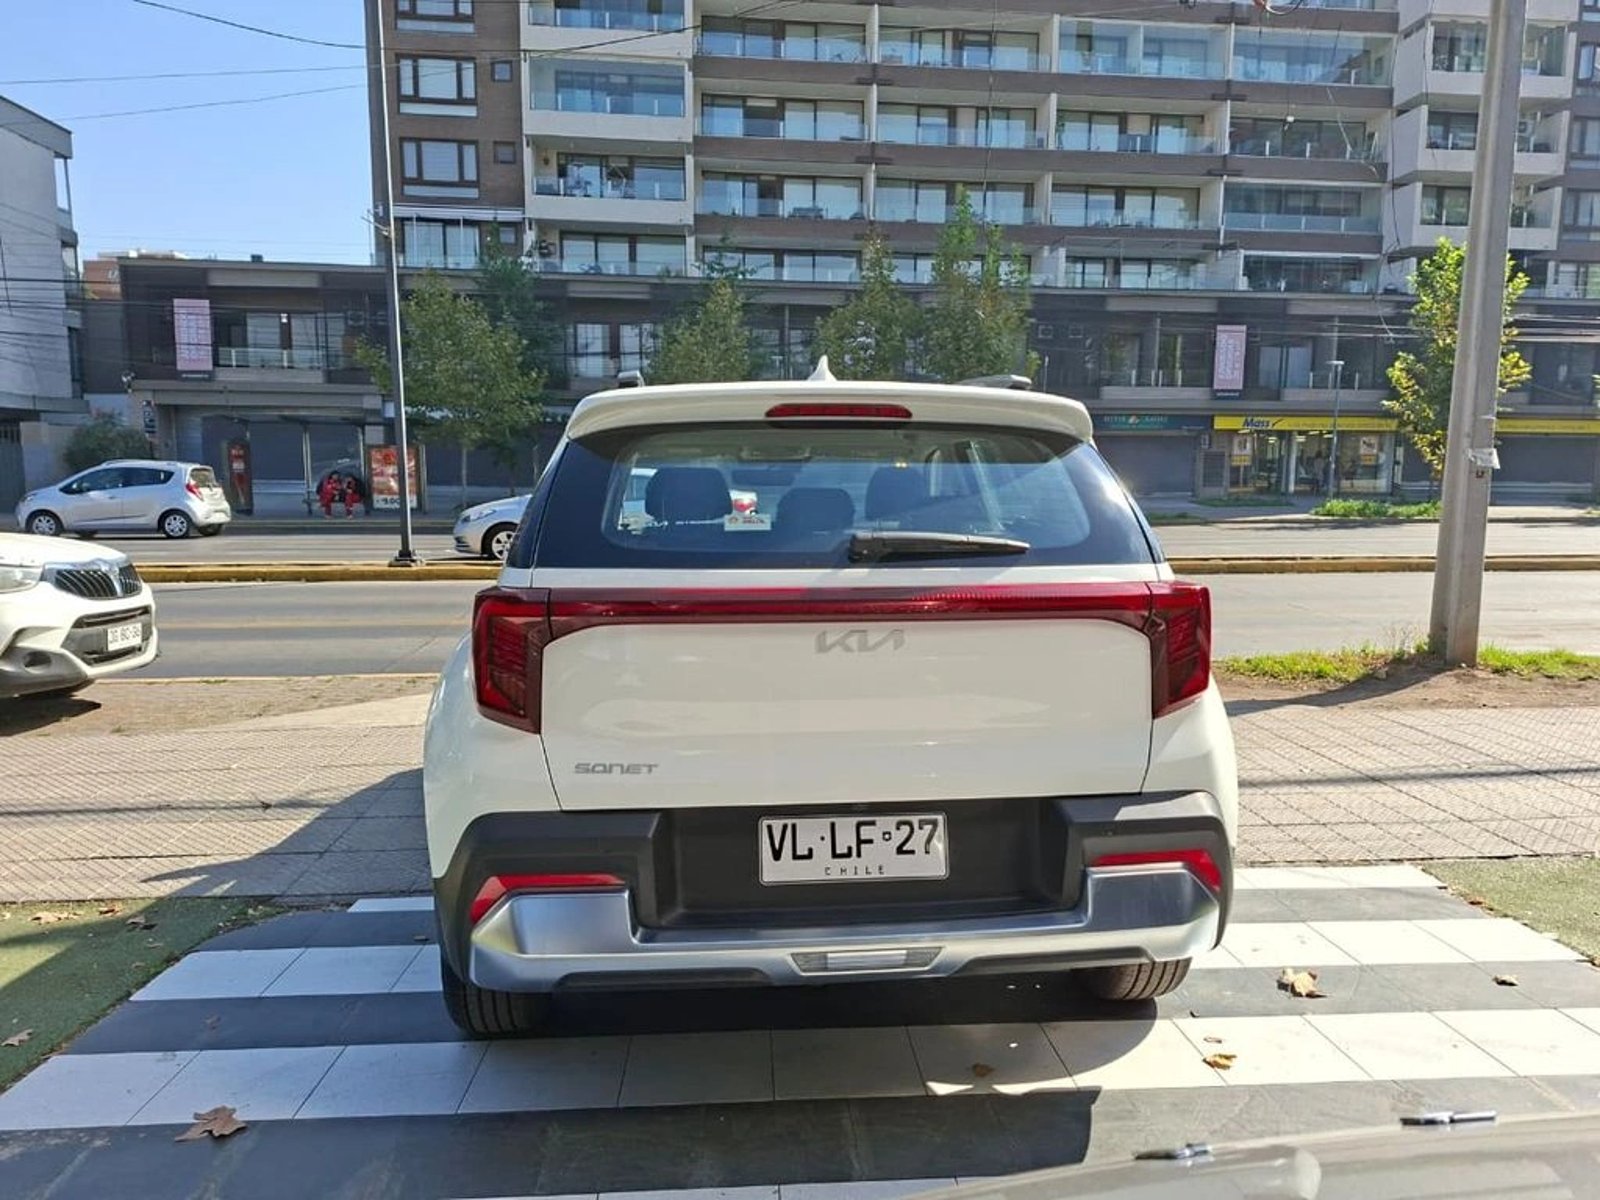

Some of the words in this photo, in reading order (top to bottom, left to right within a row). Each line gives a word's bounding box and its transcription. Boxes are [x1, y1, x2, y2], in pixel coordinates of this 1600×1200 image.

[815, 629, 905, 653] KIA
[574, 762, 659, 775] SONET
[824, 865, 885, 876] CHILE
